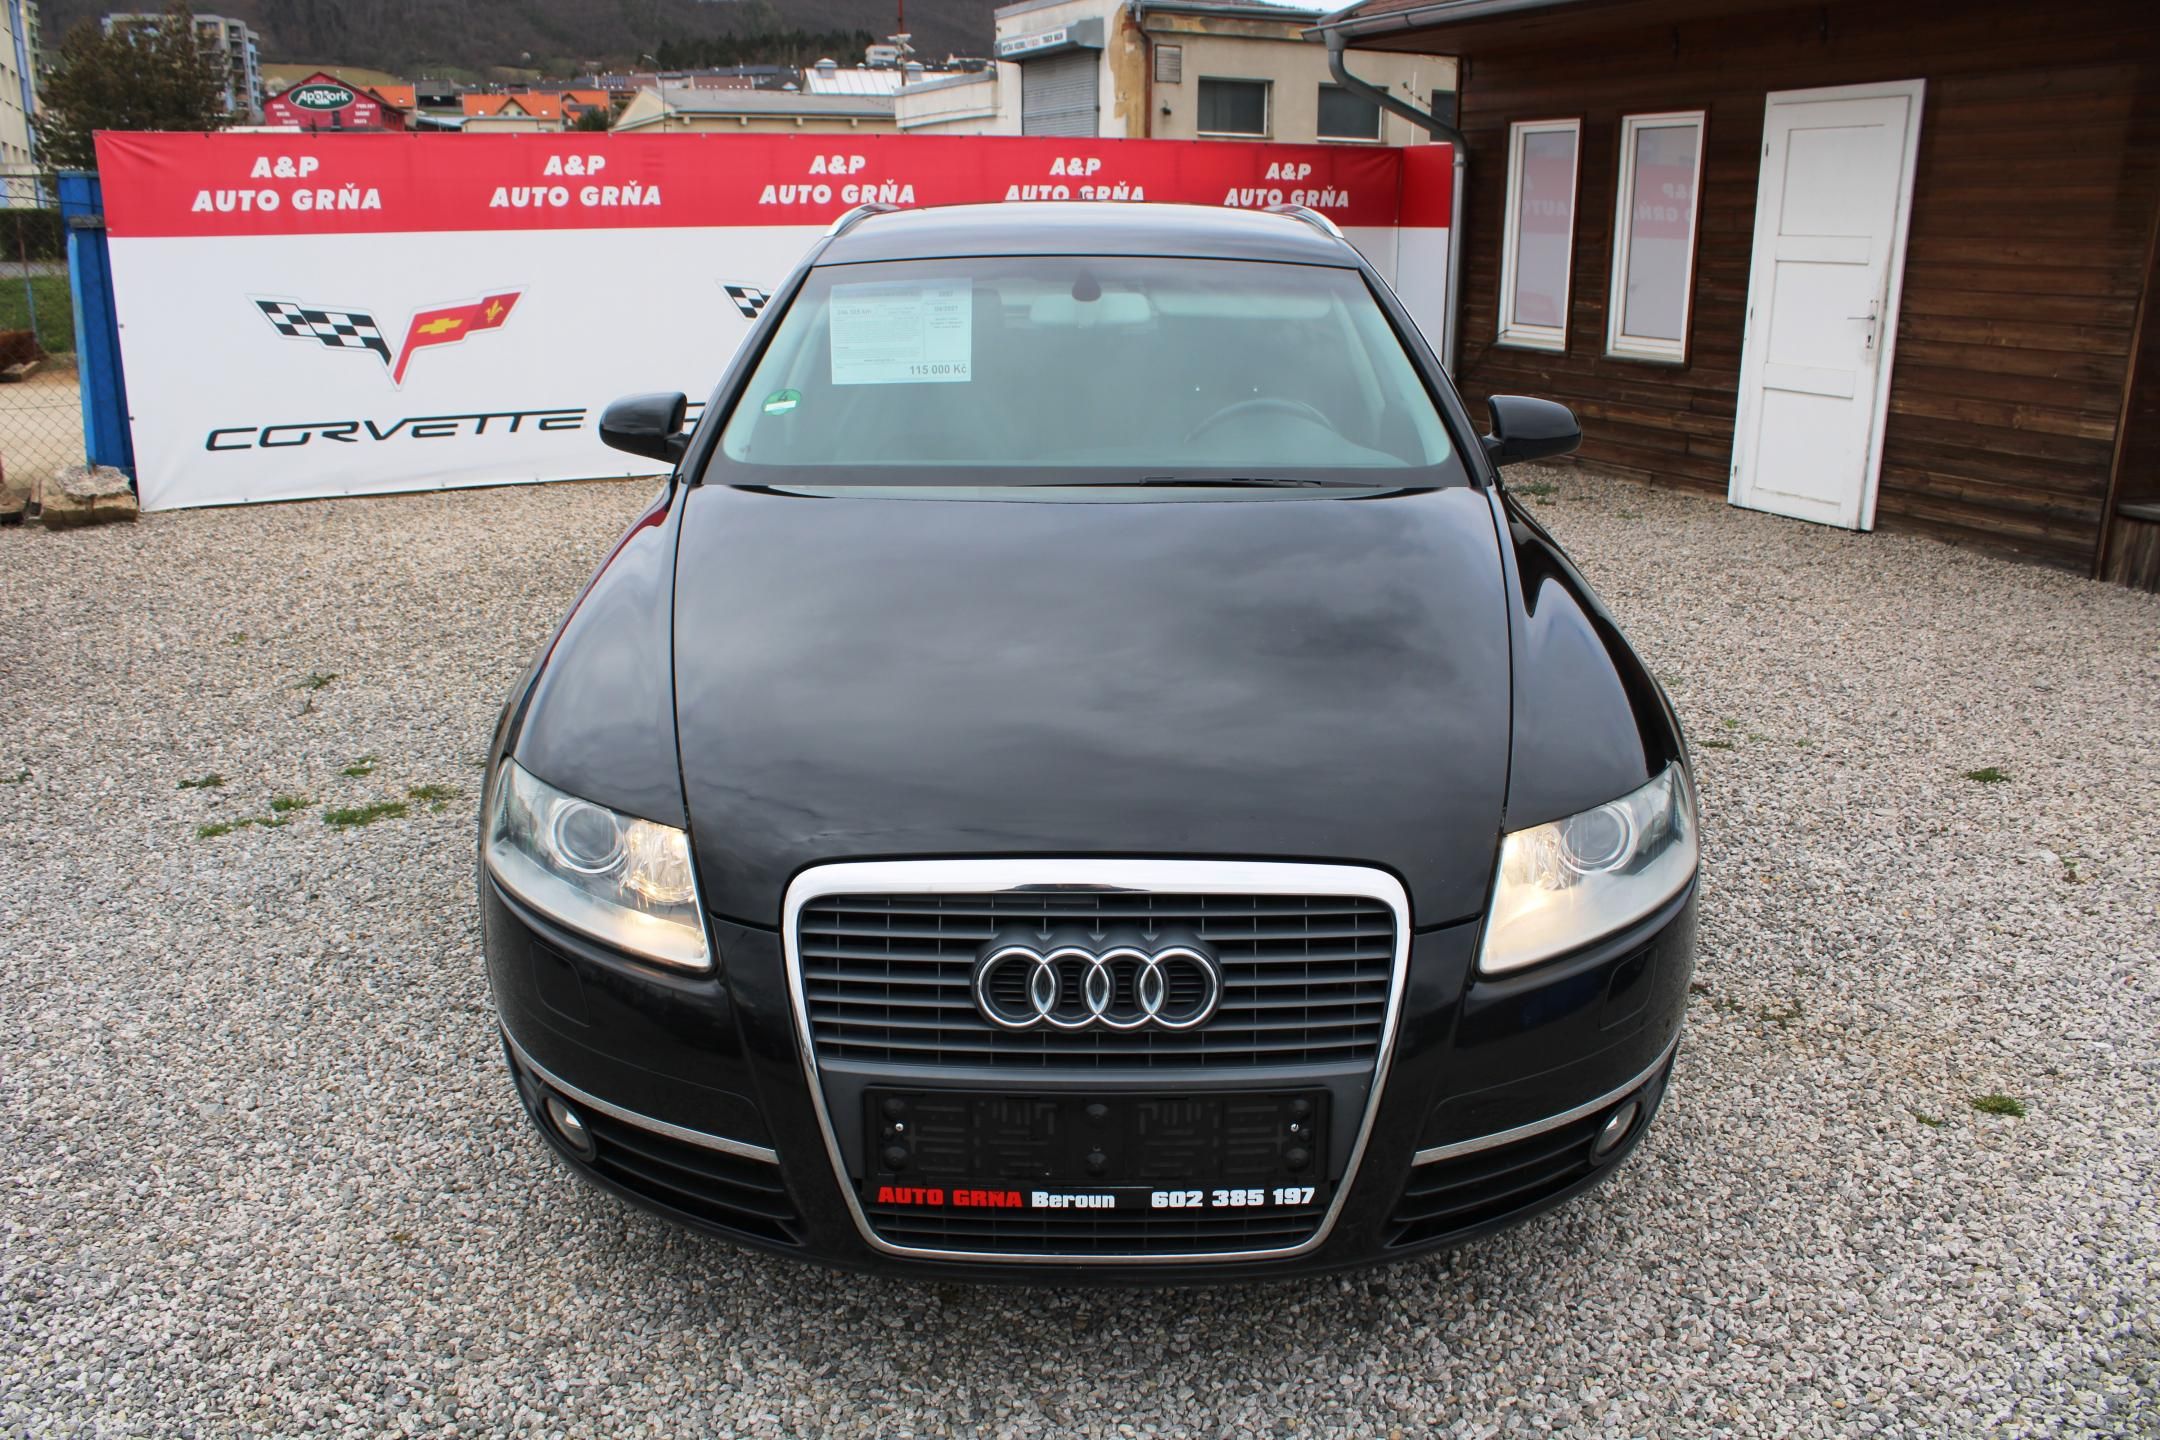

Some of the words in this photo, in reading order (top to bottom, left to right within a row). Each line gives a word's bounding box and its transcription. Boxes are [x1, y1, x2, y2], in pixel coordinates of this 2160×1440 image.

[250, 156, 319, 178] A&P
[543, 155, 606, 176] A&P
[809, 155, 866, 174] A&P
[1049, 157, 1101, 176] A&P
[1265, 162, 1312, 180] A&P
[191, 189, 280, 212] AUTO
[291, 183, 382, 211] GRŇA
[488, 186, 570, 207] AUTO
[580, 180, 661, 206] GRŇA
[758, 185, 832, 204] AUTO
[841, 179, 915, 204] GRŇA
[1004, 184, 1070, 201] AUTO
[1223, 188, 1283, 206] AUTO
[1290, 185, 1349, 208] GRŇA
[909, 365, 929, 375] 115
[931, 364, 950, 374] 000
[953, 363, 967, 374] Kč
[205, 408, 587, 452] CORVETTE
[878, 1186, 944, 1205] AUTO
[1031, 1191, 1115, 1208] Beroun
[1151, 1190, 1204, 1208] 602
[1212, 1189, 1265, 1207] 385
[1272, 1187, 1316, 1205] 197
